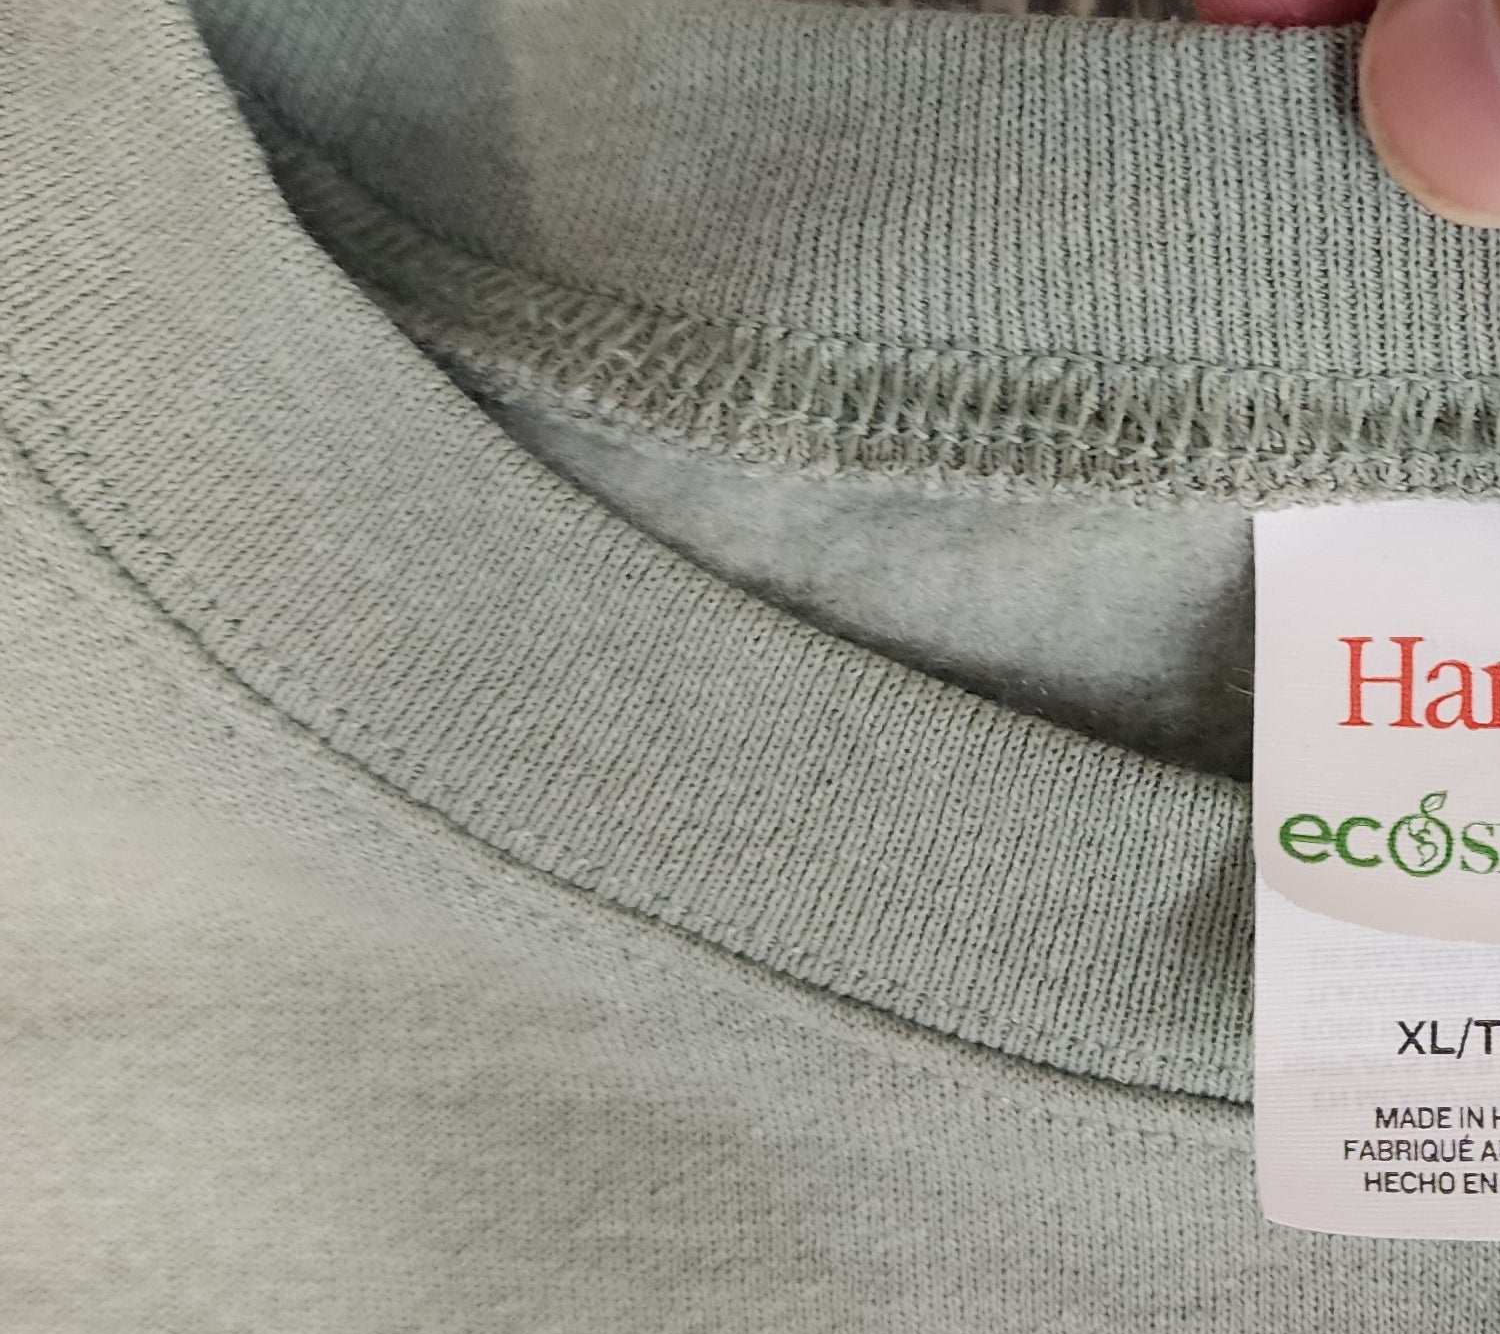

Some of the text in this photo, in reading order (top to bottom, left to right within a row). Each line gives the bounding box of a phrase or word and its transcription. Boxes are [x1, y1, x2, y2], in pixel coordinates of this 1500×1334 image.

[1375, 1105, 1451, 1129] MADE
[1459, 1106, 1484, 1129] IN
[1343, 1134, 1474, 1162] FABRIQUÉ
[1364, 1171, 1456, 1194] HECHO
[1463, 1172, 1498, 1195] EN
